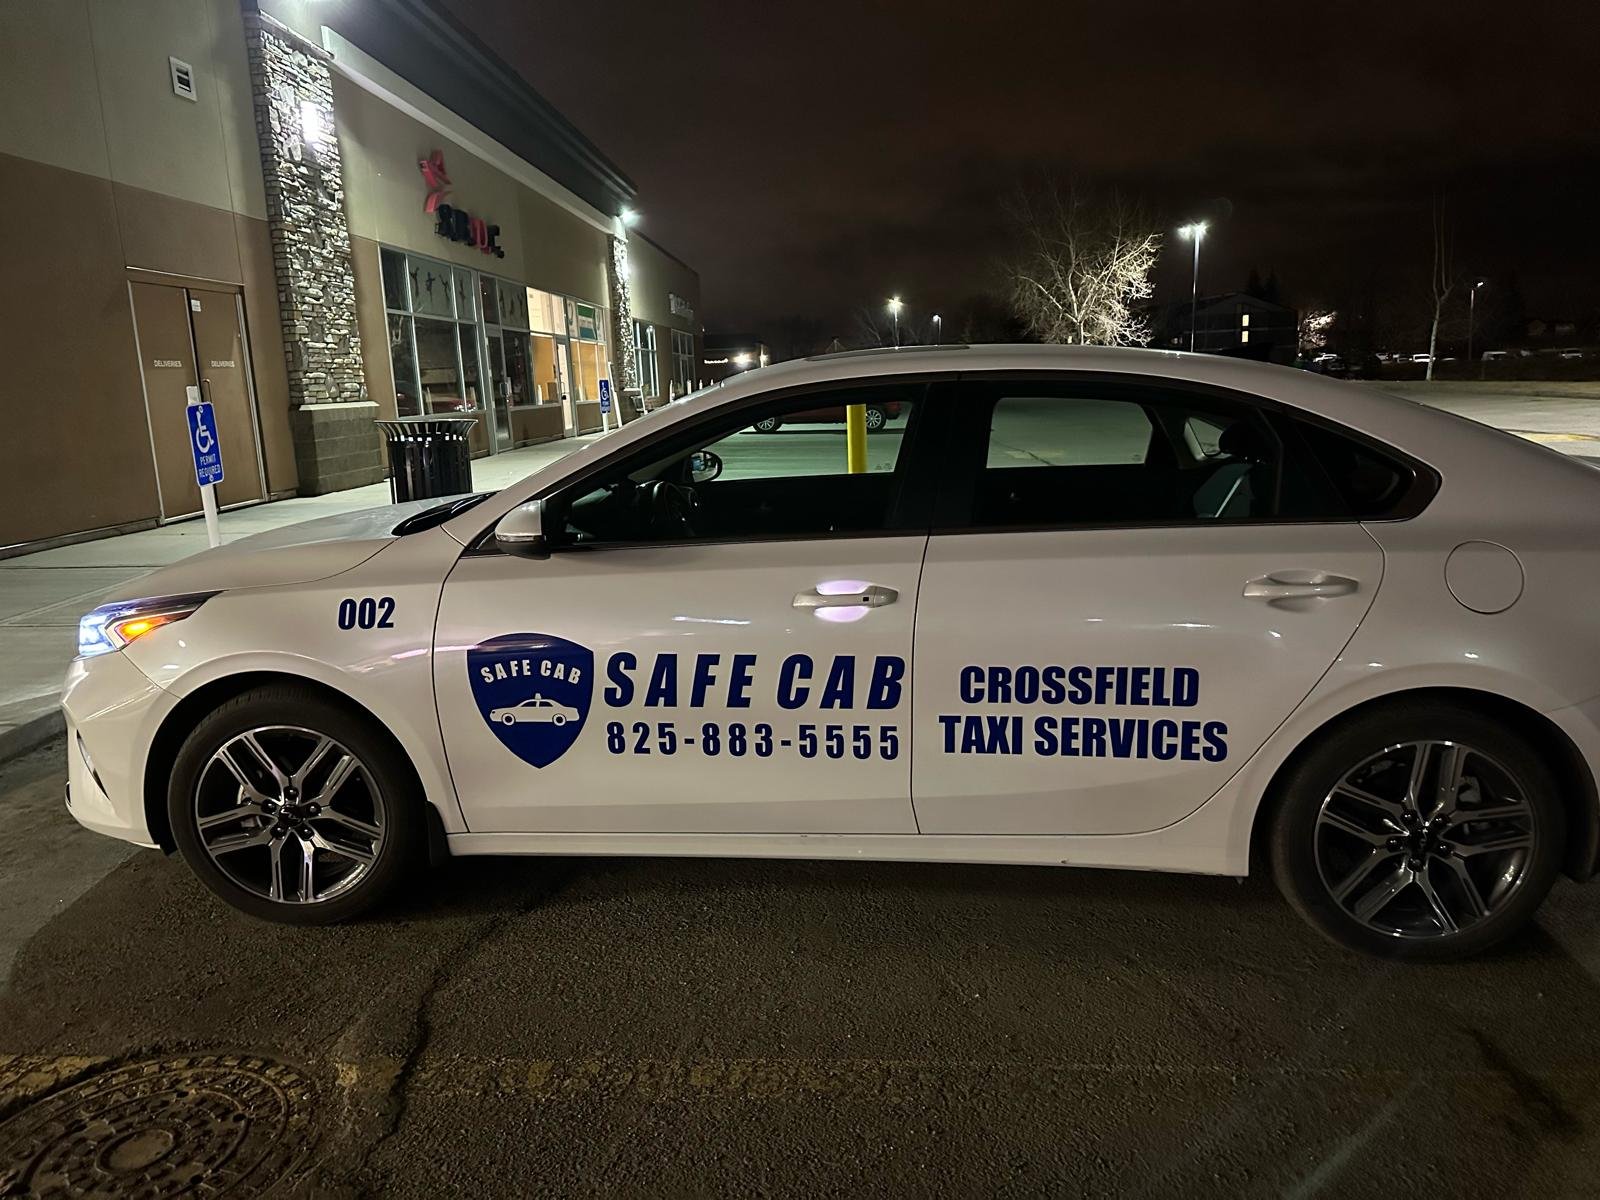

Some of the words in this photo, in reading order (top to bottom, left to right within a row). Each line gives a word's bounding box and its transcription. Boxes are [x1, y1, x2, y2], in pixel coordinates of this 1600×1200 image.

[198, 464, 221, 478] REQUIRED
[200, 453, 216, 466] PERMIT
[338, 597, 395, 630] 002
[480, 659, 532, 684] SAFE
[540, 660, 581, 685] CAB
[604, 652, 757, 708] SAFE
[776, 653, 905, 710] CAB
[960, 665, 1199, 707] CROSSFIELD
[606, 721, 899, 760] 825-883-5555
[938, 715, 1023, 755] TAXI
[1034, 716, 1228, 762] SERVICES
